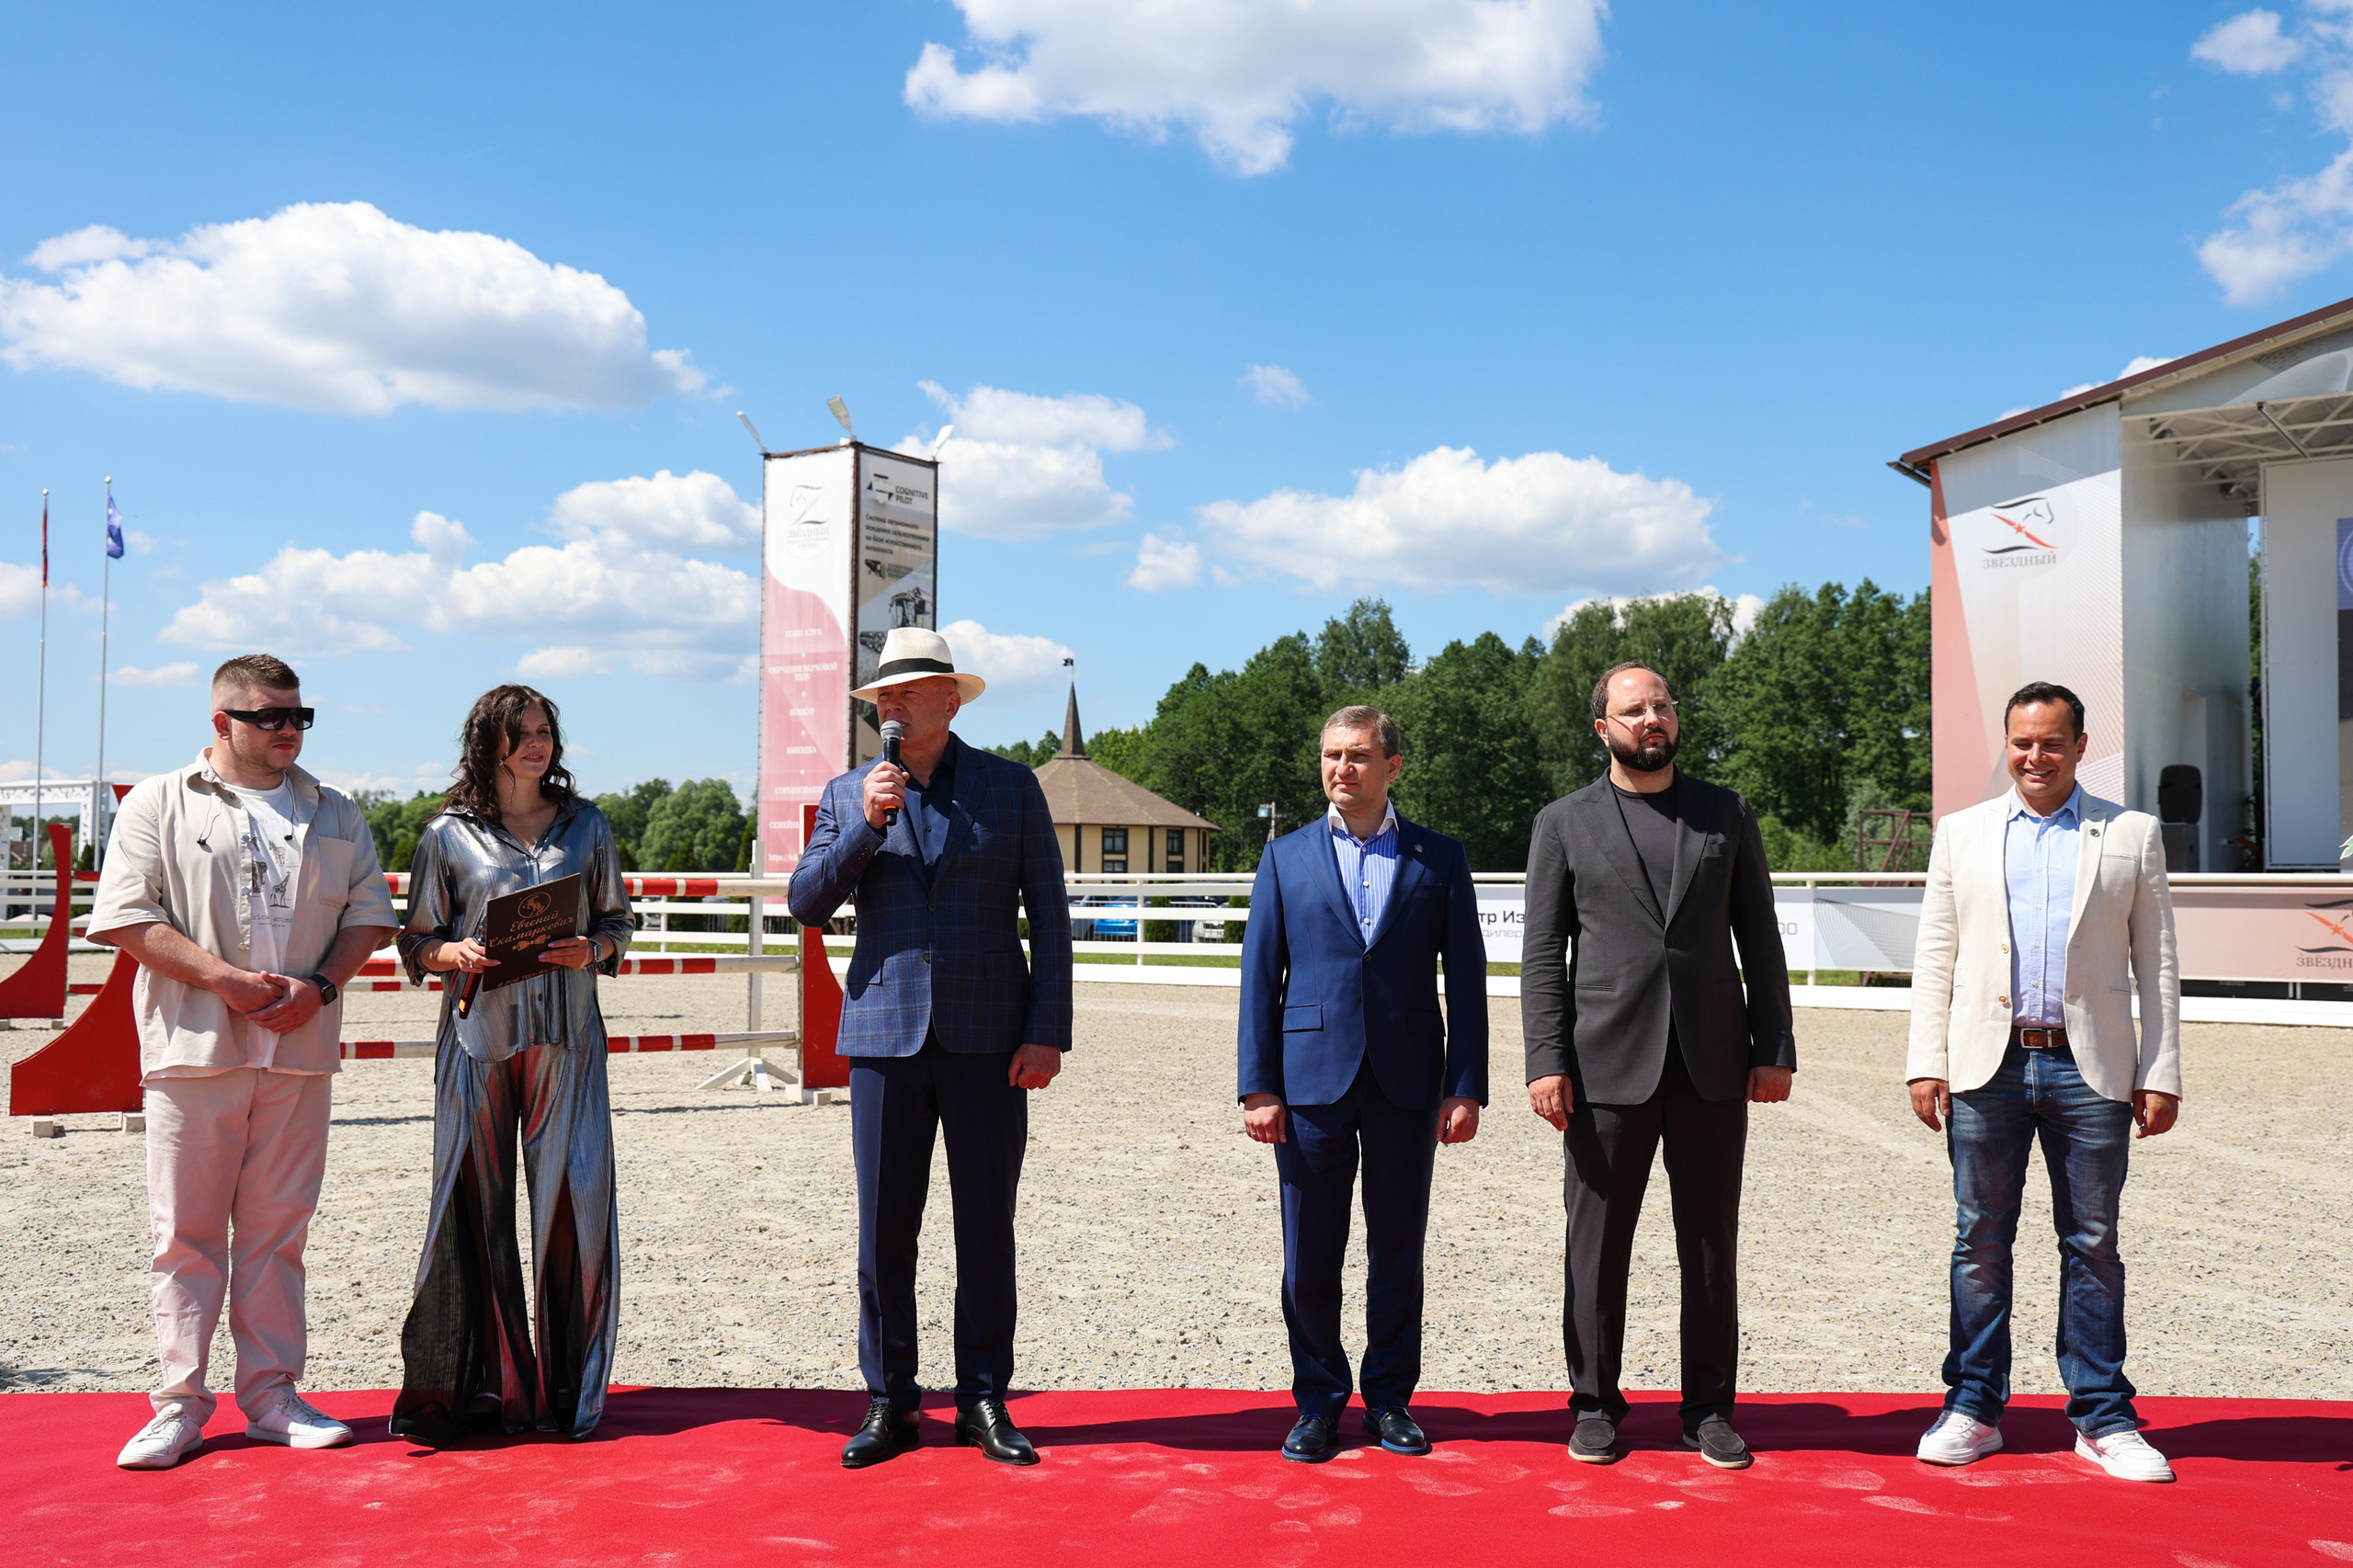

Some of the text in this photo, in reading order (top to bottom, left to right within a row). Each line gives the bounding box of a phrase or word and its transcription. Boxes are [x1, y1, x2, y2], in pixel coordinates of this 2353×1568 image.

[895, 485, 928, 500] COGNITIVE
[895, 494, 913, 505] PILOT
[509, 910, 560, 932] Евгений
[1482, 929, 1523, 938] дилер
